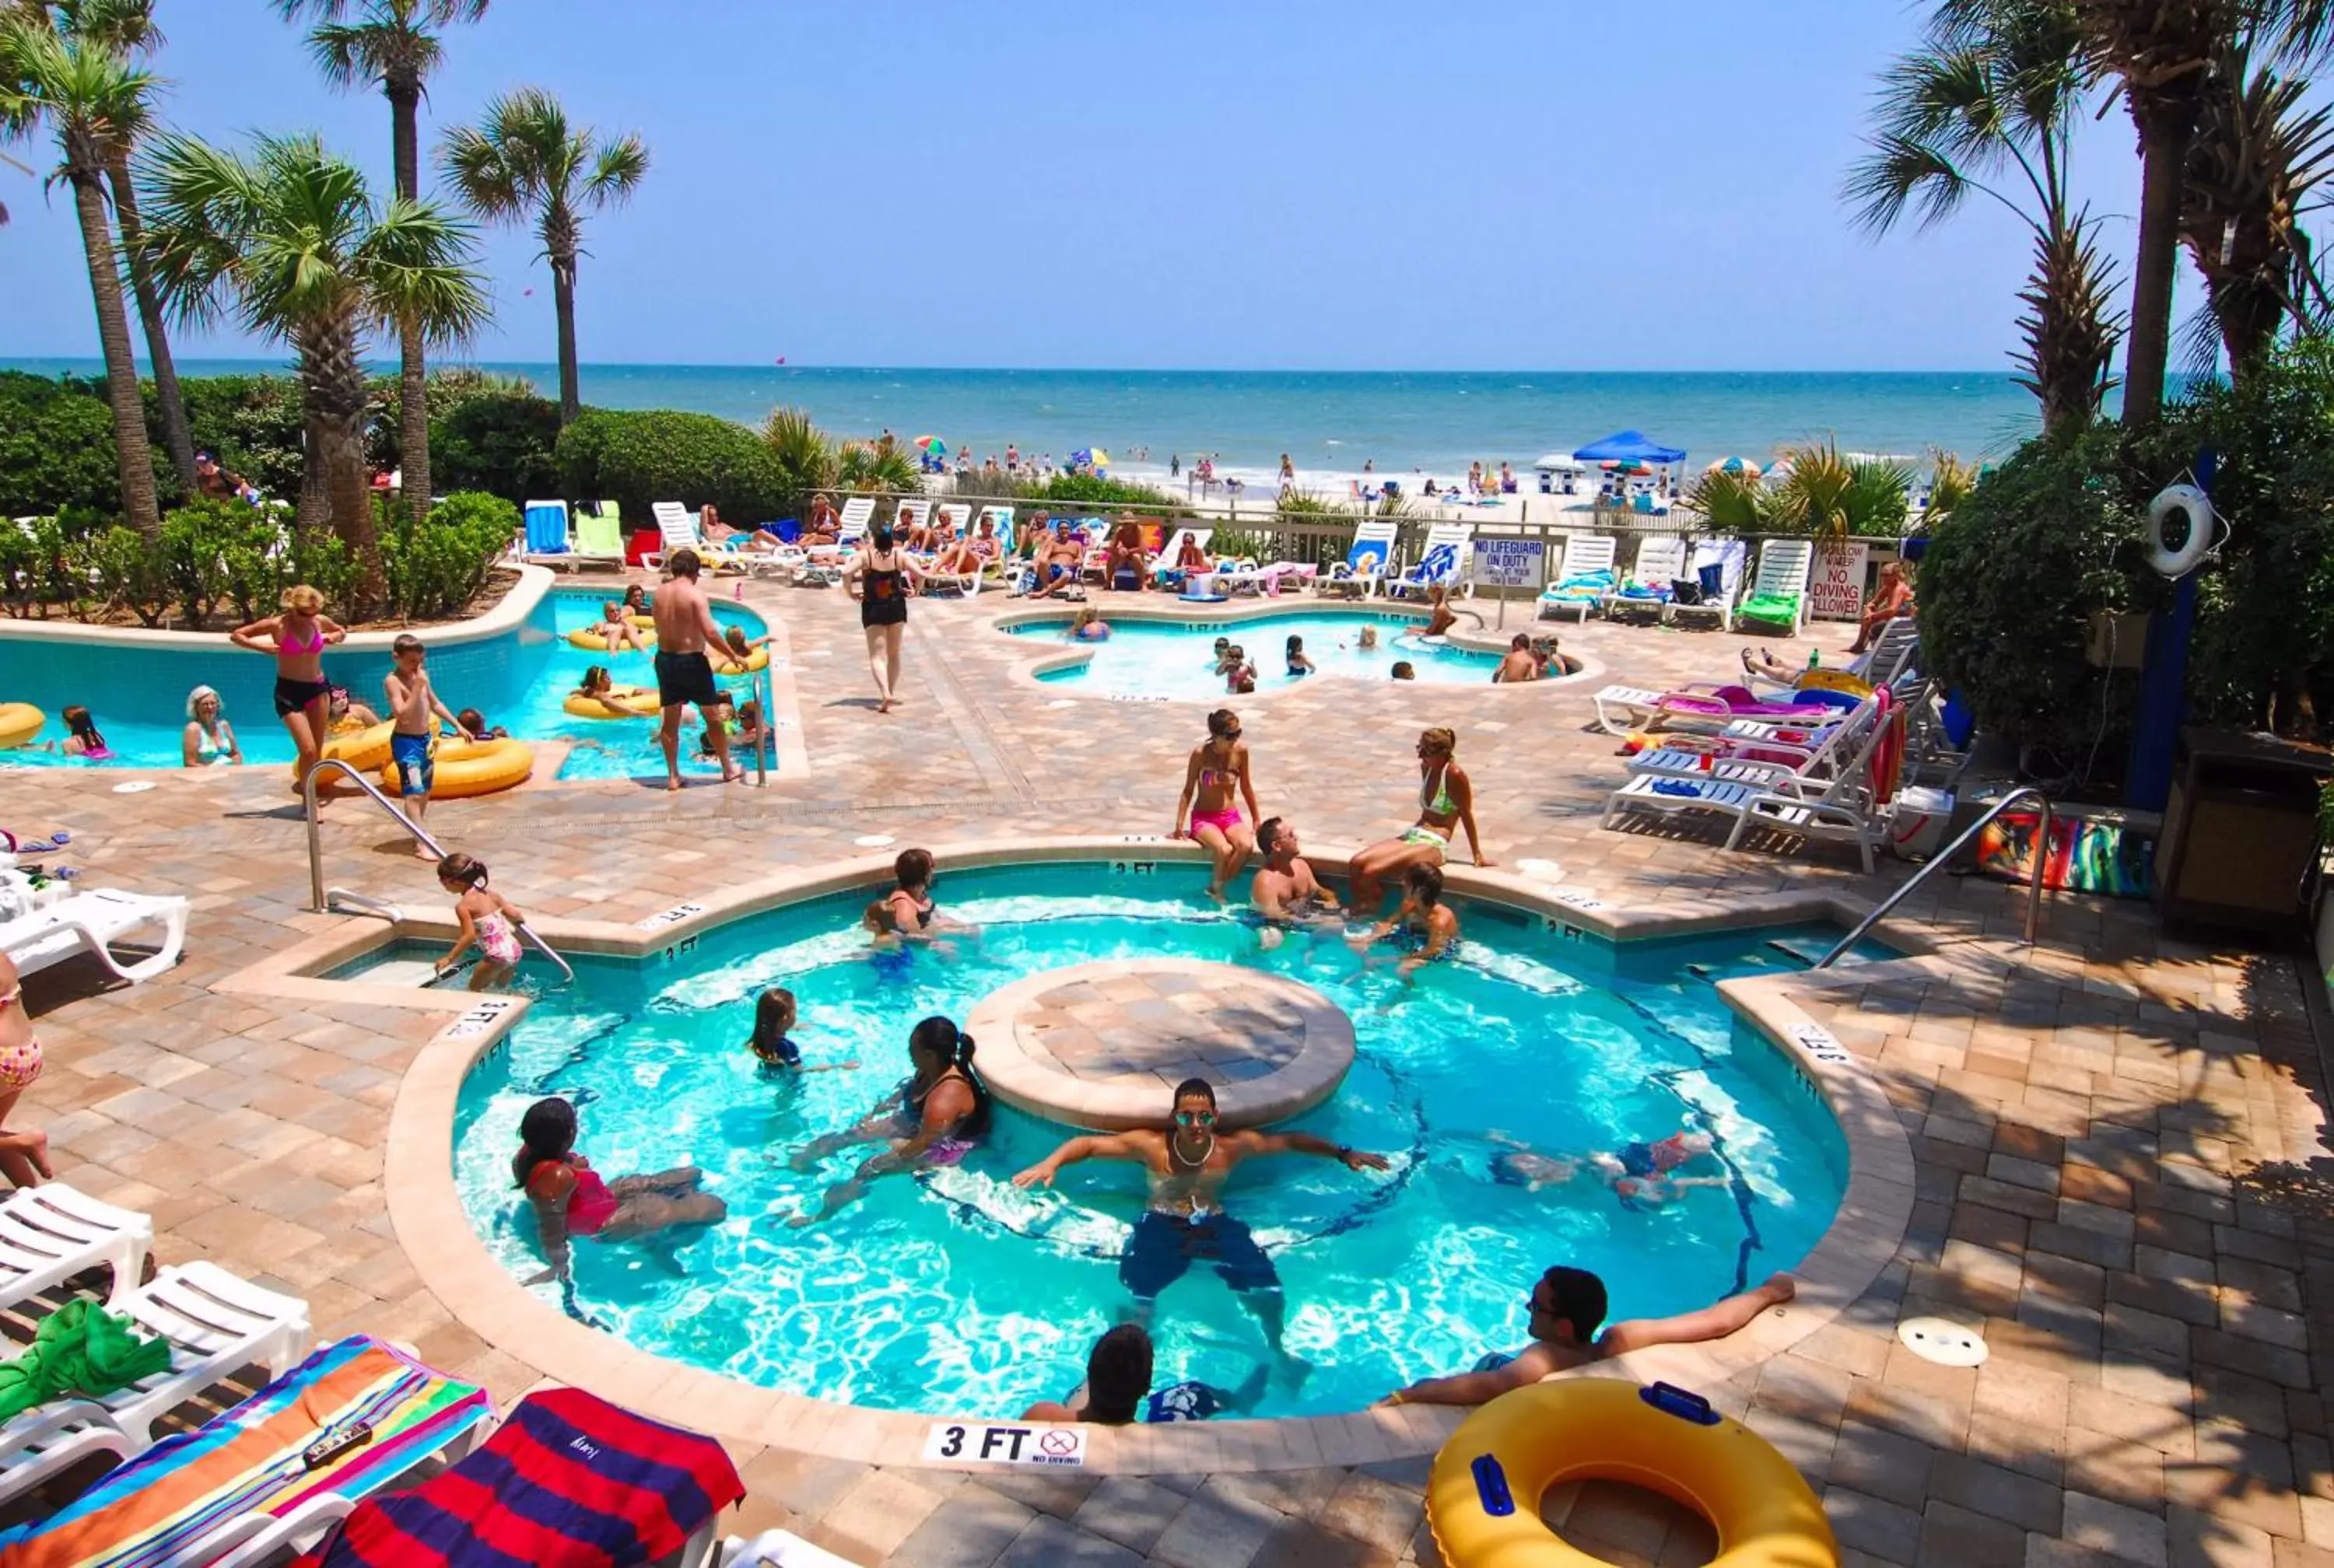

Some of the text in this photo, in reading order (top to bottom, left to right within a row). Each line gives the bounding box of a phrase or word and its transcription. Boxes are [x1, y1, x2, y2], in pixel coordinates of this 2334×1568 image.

[1475, 541, 1542, 555] NO LIFEGUARD
[1487, 554, 1530, 567] ON DUTY
[1828, 570, 1848, 583] NO
[1814, 583, 1859, 599] DIVING
[1134, 862, 1155, 874] FT
[463, 1011, 499, 1024] FT
[1799, 1037, 1838, 1049] FT
[941, 1426, 1032, 1461] 3 FT
[1048, 1455, 1081, 1465] DIVING
